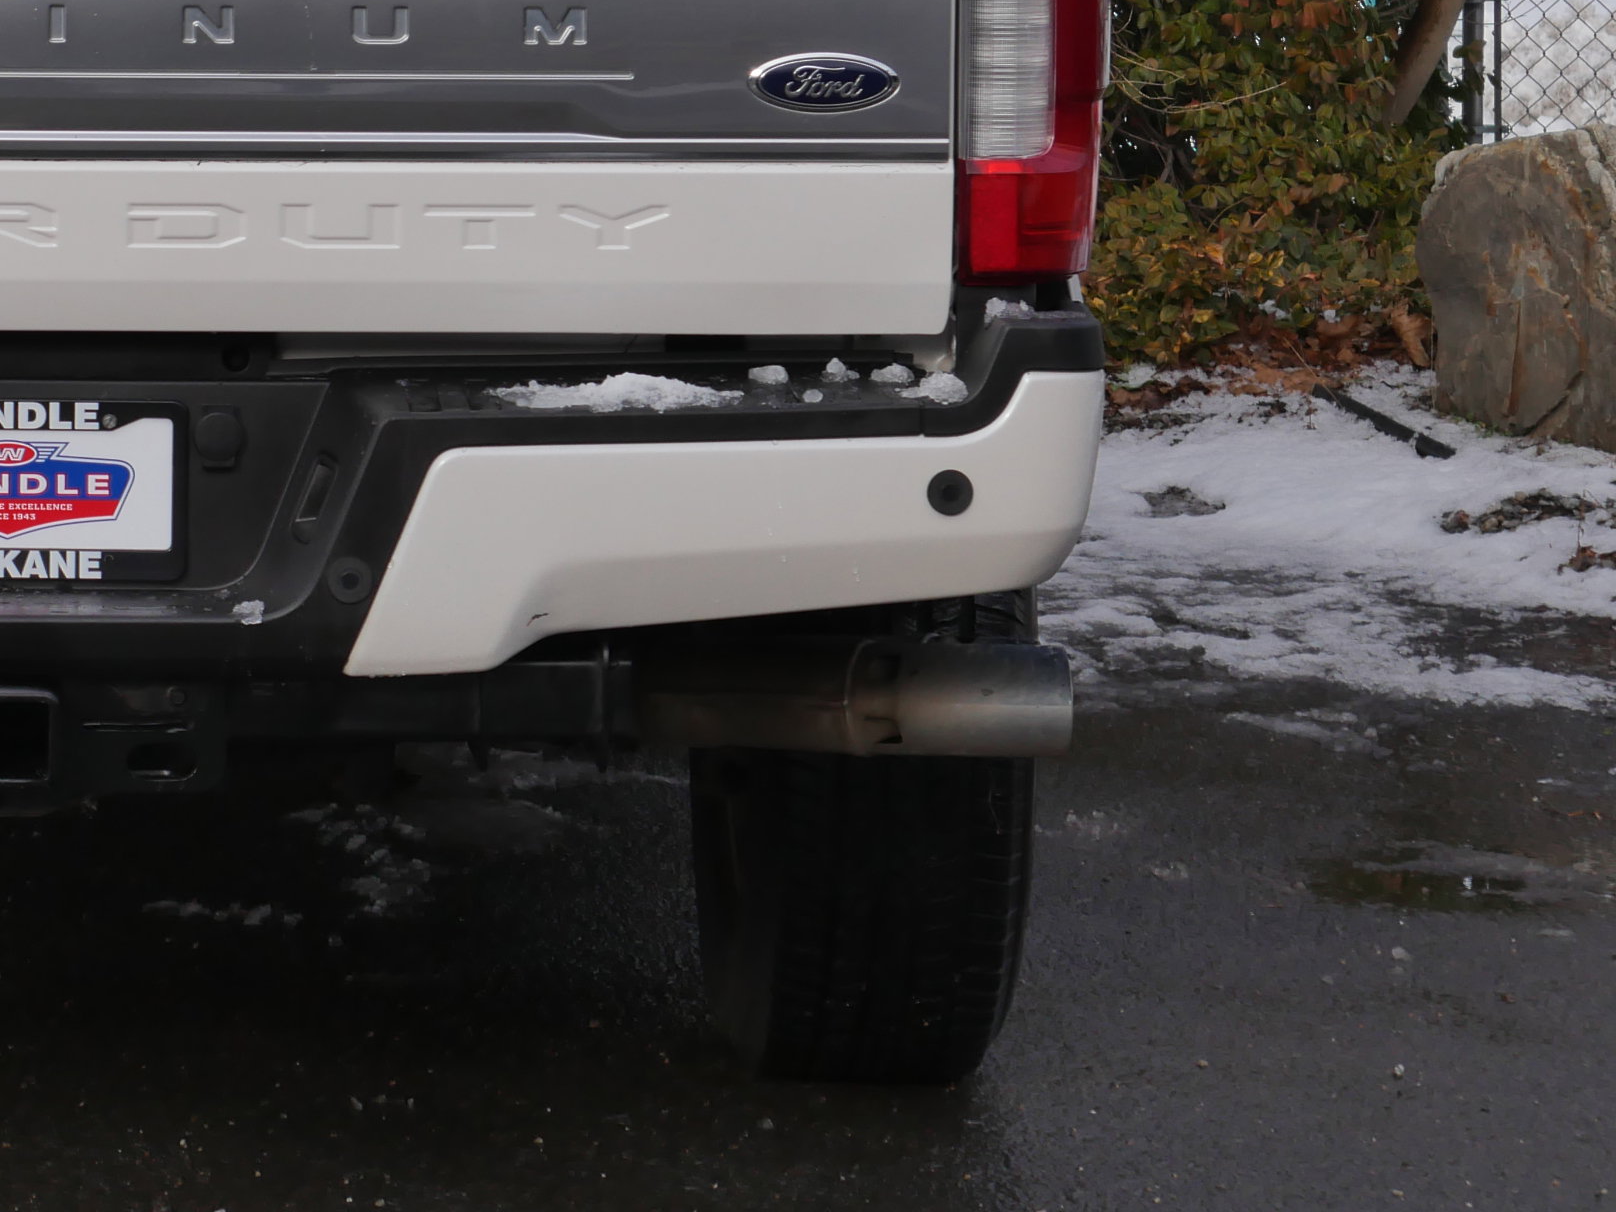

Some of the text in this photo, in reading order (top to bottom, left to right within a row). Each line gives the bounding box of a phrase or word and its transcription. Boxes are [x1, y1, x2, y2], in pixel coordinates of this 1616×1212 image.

[784, 64, 866, 99] Ford
[125, 202, 671, 251] DUTY
[8, 502, 73, 511] EXCELLENCE
[12, 512, 36, 521] 1943
